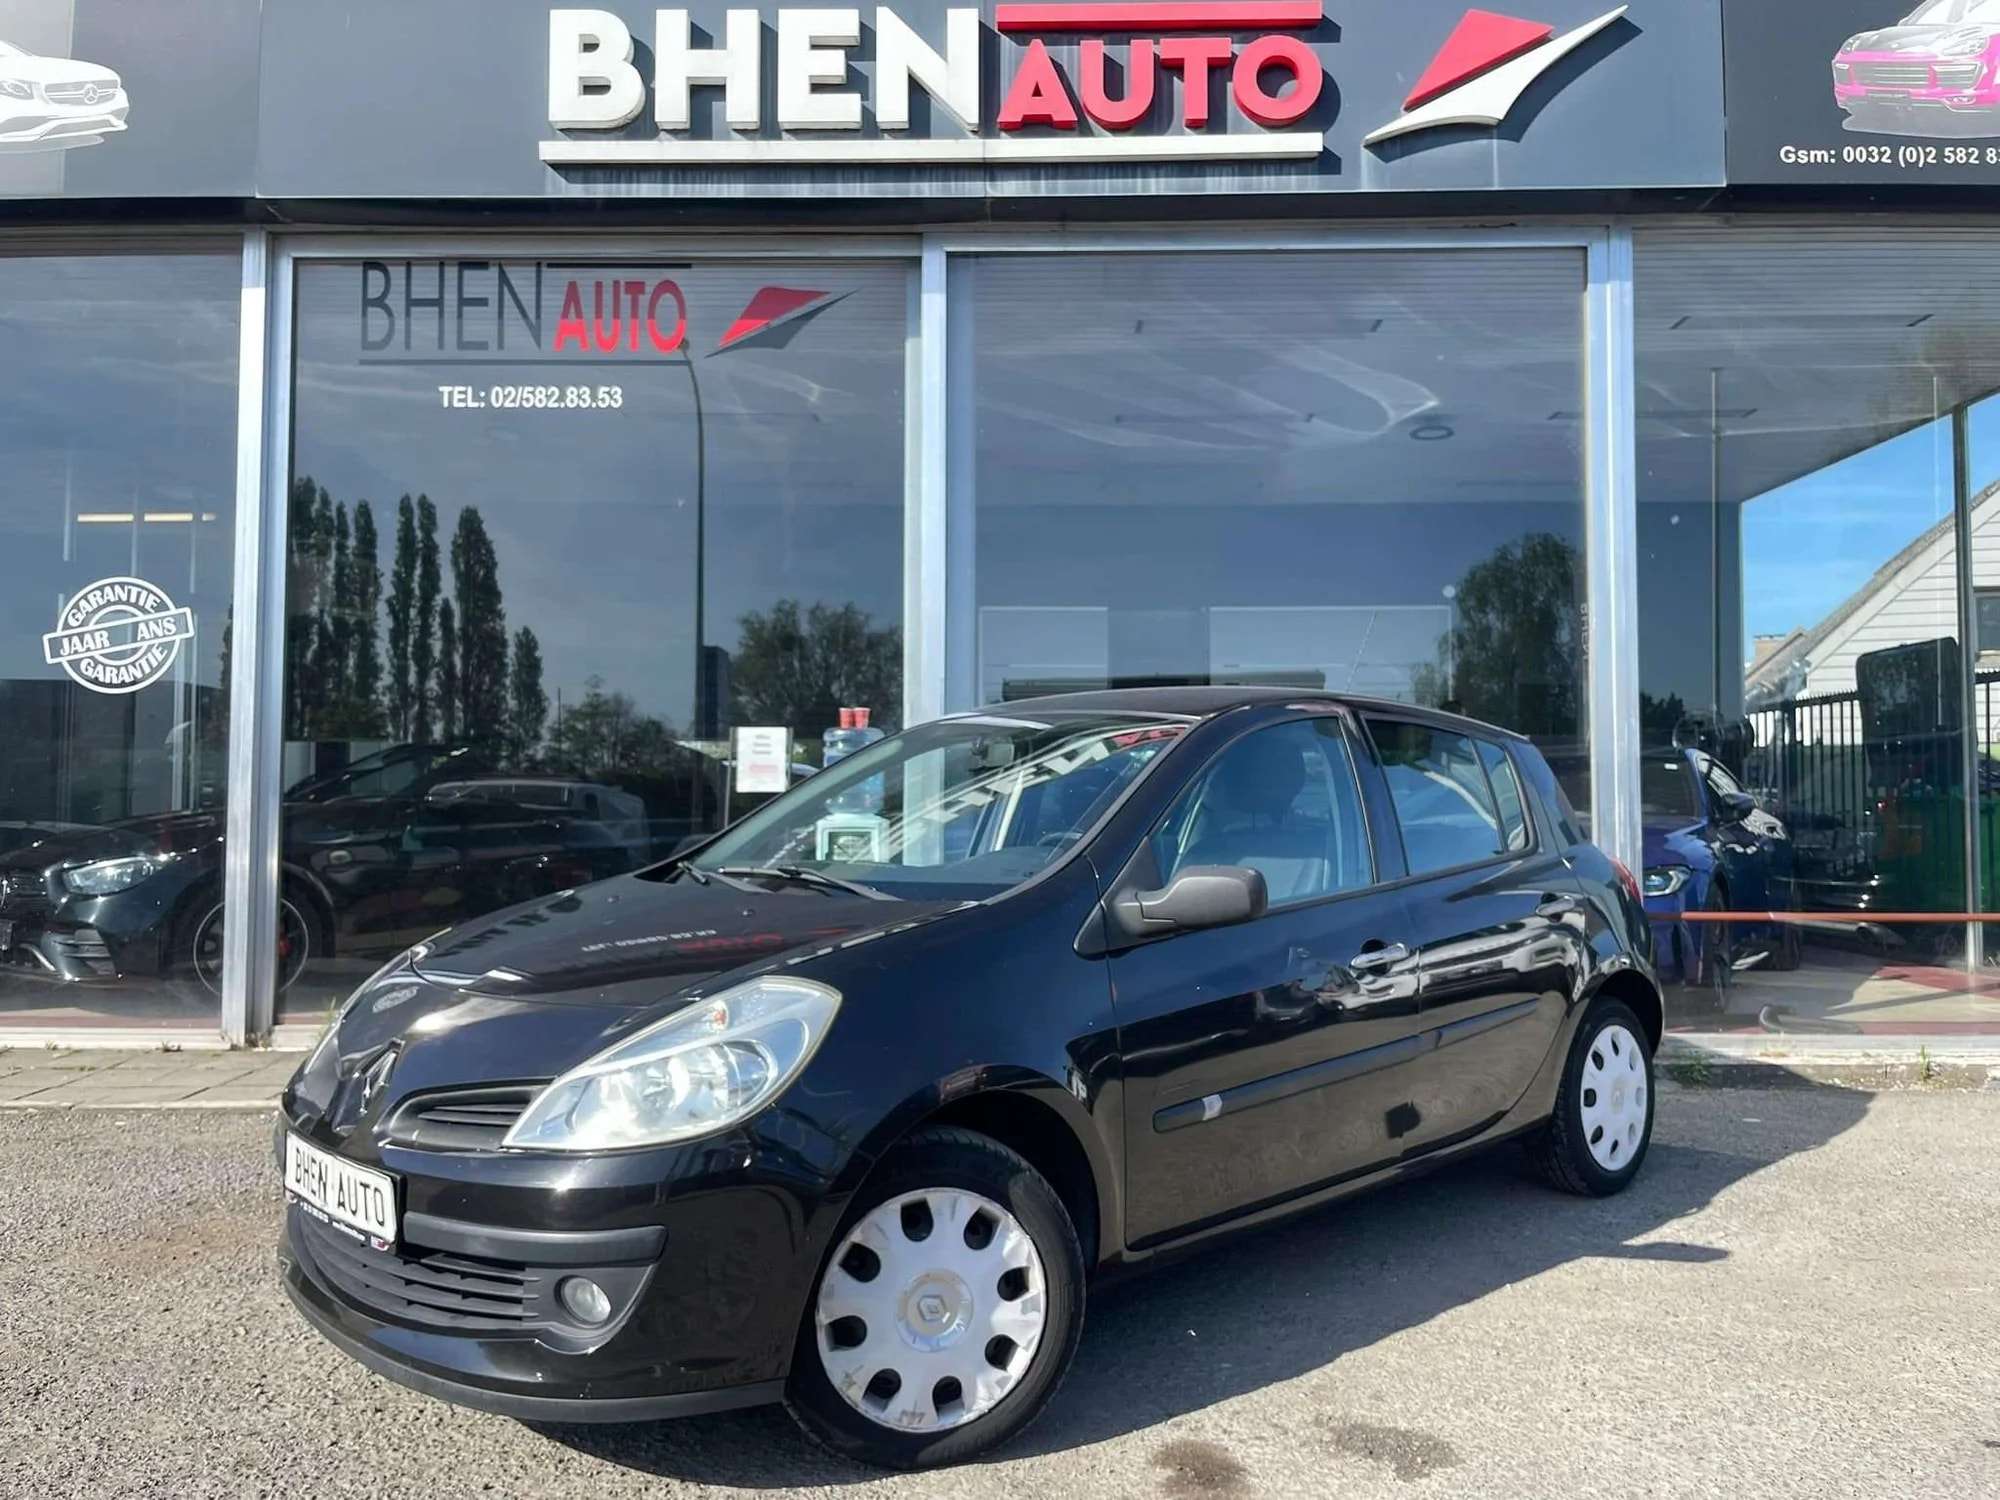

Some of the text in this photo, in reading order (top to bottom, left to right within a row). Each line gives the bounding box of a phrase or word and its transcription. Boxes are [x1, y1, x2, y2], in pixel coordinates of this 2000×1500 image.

[548, 7, 1323, 131] BHEN AUTO
[1779, 146, 2000, 168] Gsm: 0032 (0)2 582 8
[361, 261, 687, 353] BHEN AUTO
[439, 386, 623, 409] TEL: 02/582.83.53
[67, 584, 161, 627] GARANTIE
[60, 617, 177, 656] JAAR ANS
[80, 645, 168, 684] GARANTIE
[295, 1147, 385, 1228] BHEN AUTO
